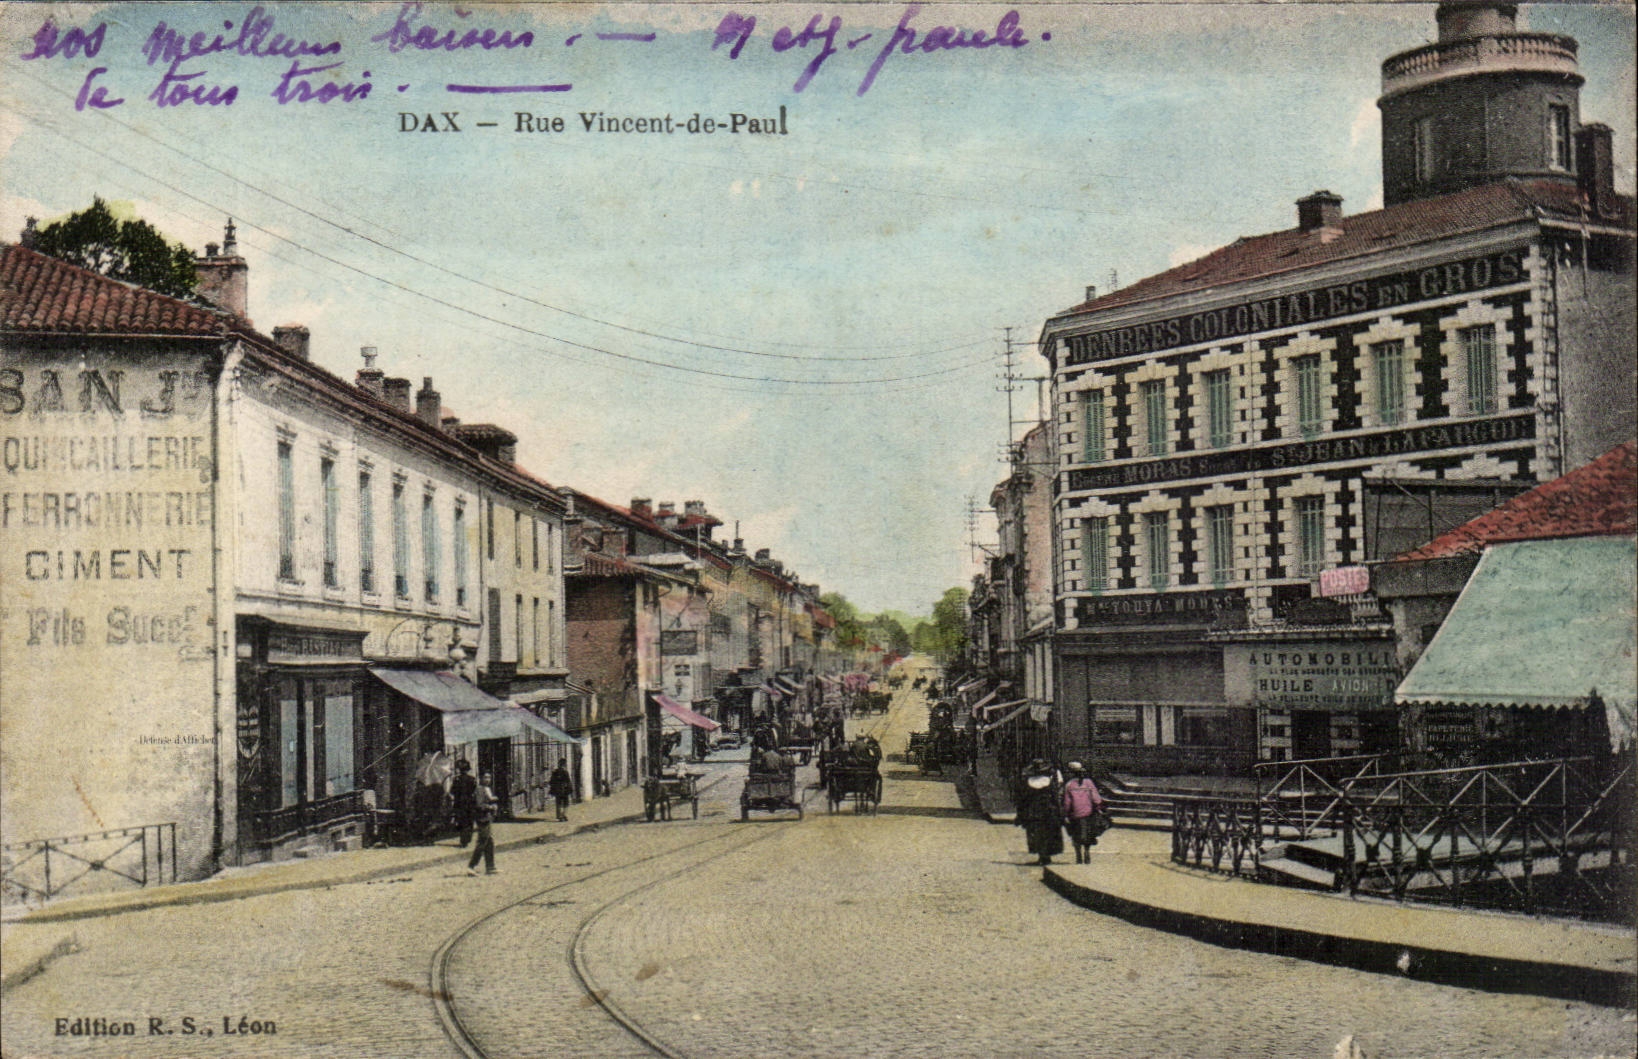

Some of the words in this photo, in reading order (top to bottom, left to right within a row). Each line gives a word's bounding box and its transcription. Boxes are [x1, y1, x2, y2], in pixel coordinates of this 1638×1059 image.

[1189, 280, 1370, 343] COLONIALES
[1376, 284, 1410, 307] EN
[1419, 251, 1520, 299] GROS
[3, 436, 205, 476] QUINCAILLERIE
[1123, 457, 1192, 484] MORAS
[1299, 436, 1366, 464] JEAN
[2, 491, 212, 530] FERRONNERIE
[25, 549, 192, 581] CIMENT
[26, 607, 86, 646] Fils
[1249, 651, 1397, 667] AUTOMOBILI
[1259, 679, 1314, 692] HUILE
[1332, 679, 1369, 692] AVION
